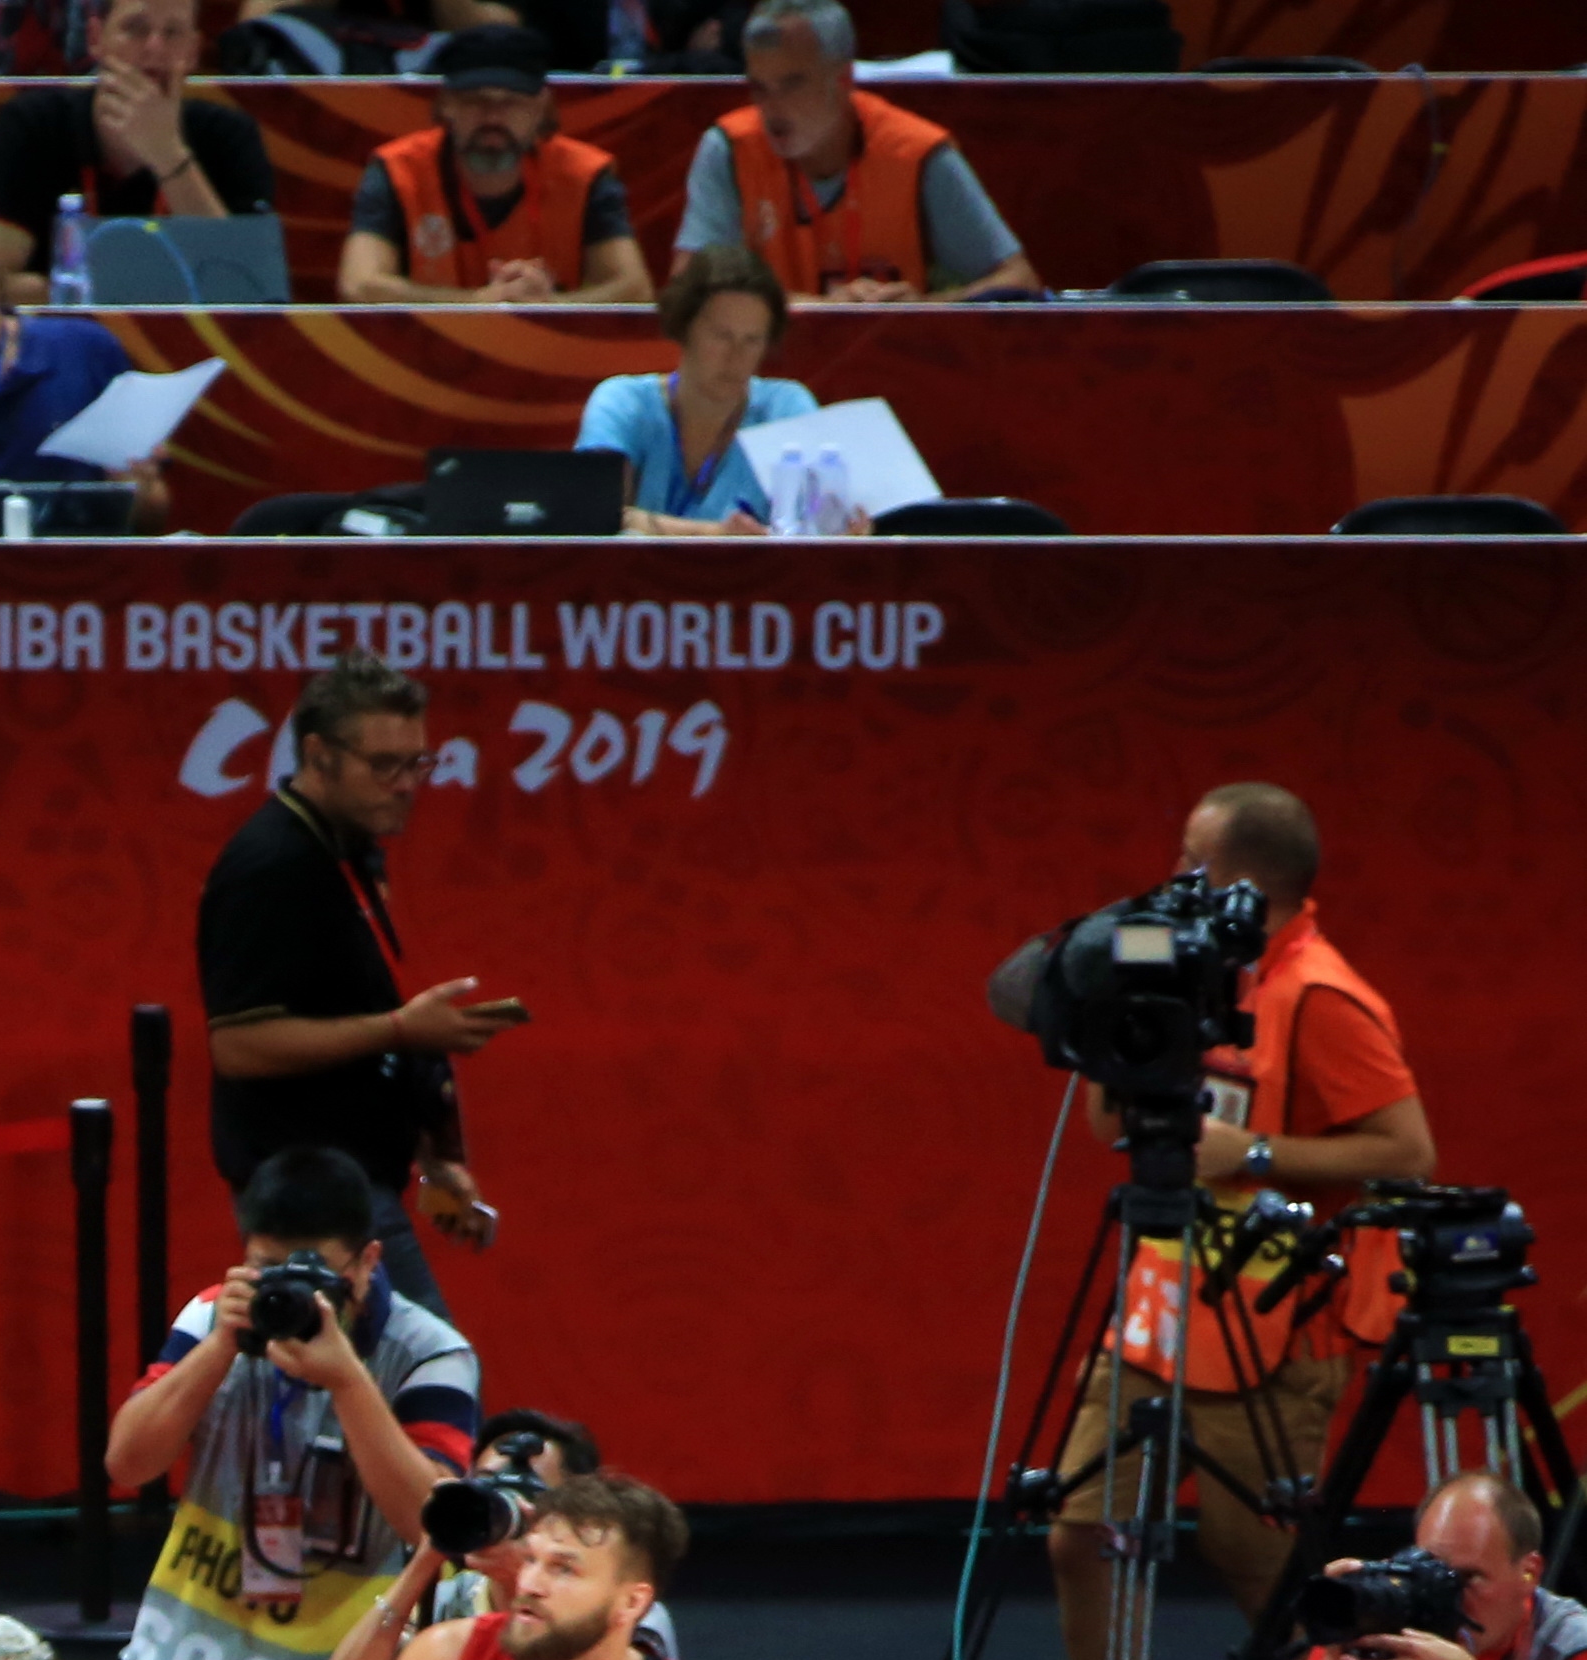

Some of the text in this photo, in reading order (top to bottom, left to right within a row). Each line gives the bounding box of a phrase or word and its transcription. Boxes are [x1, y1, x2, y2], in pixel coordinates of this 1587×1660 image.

[124, 600, 545, 672] BASKETBALL
[557, 600, 793, 671] WORLD
[812, 600, 944, 671] CUP
[508, 699, 729, 797] 2019
[169, 1524, 299, 1626] PHO
